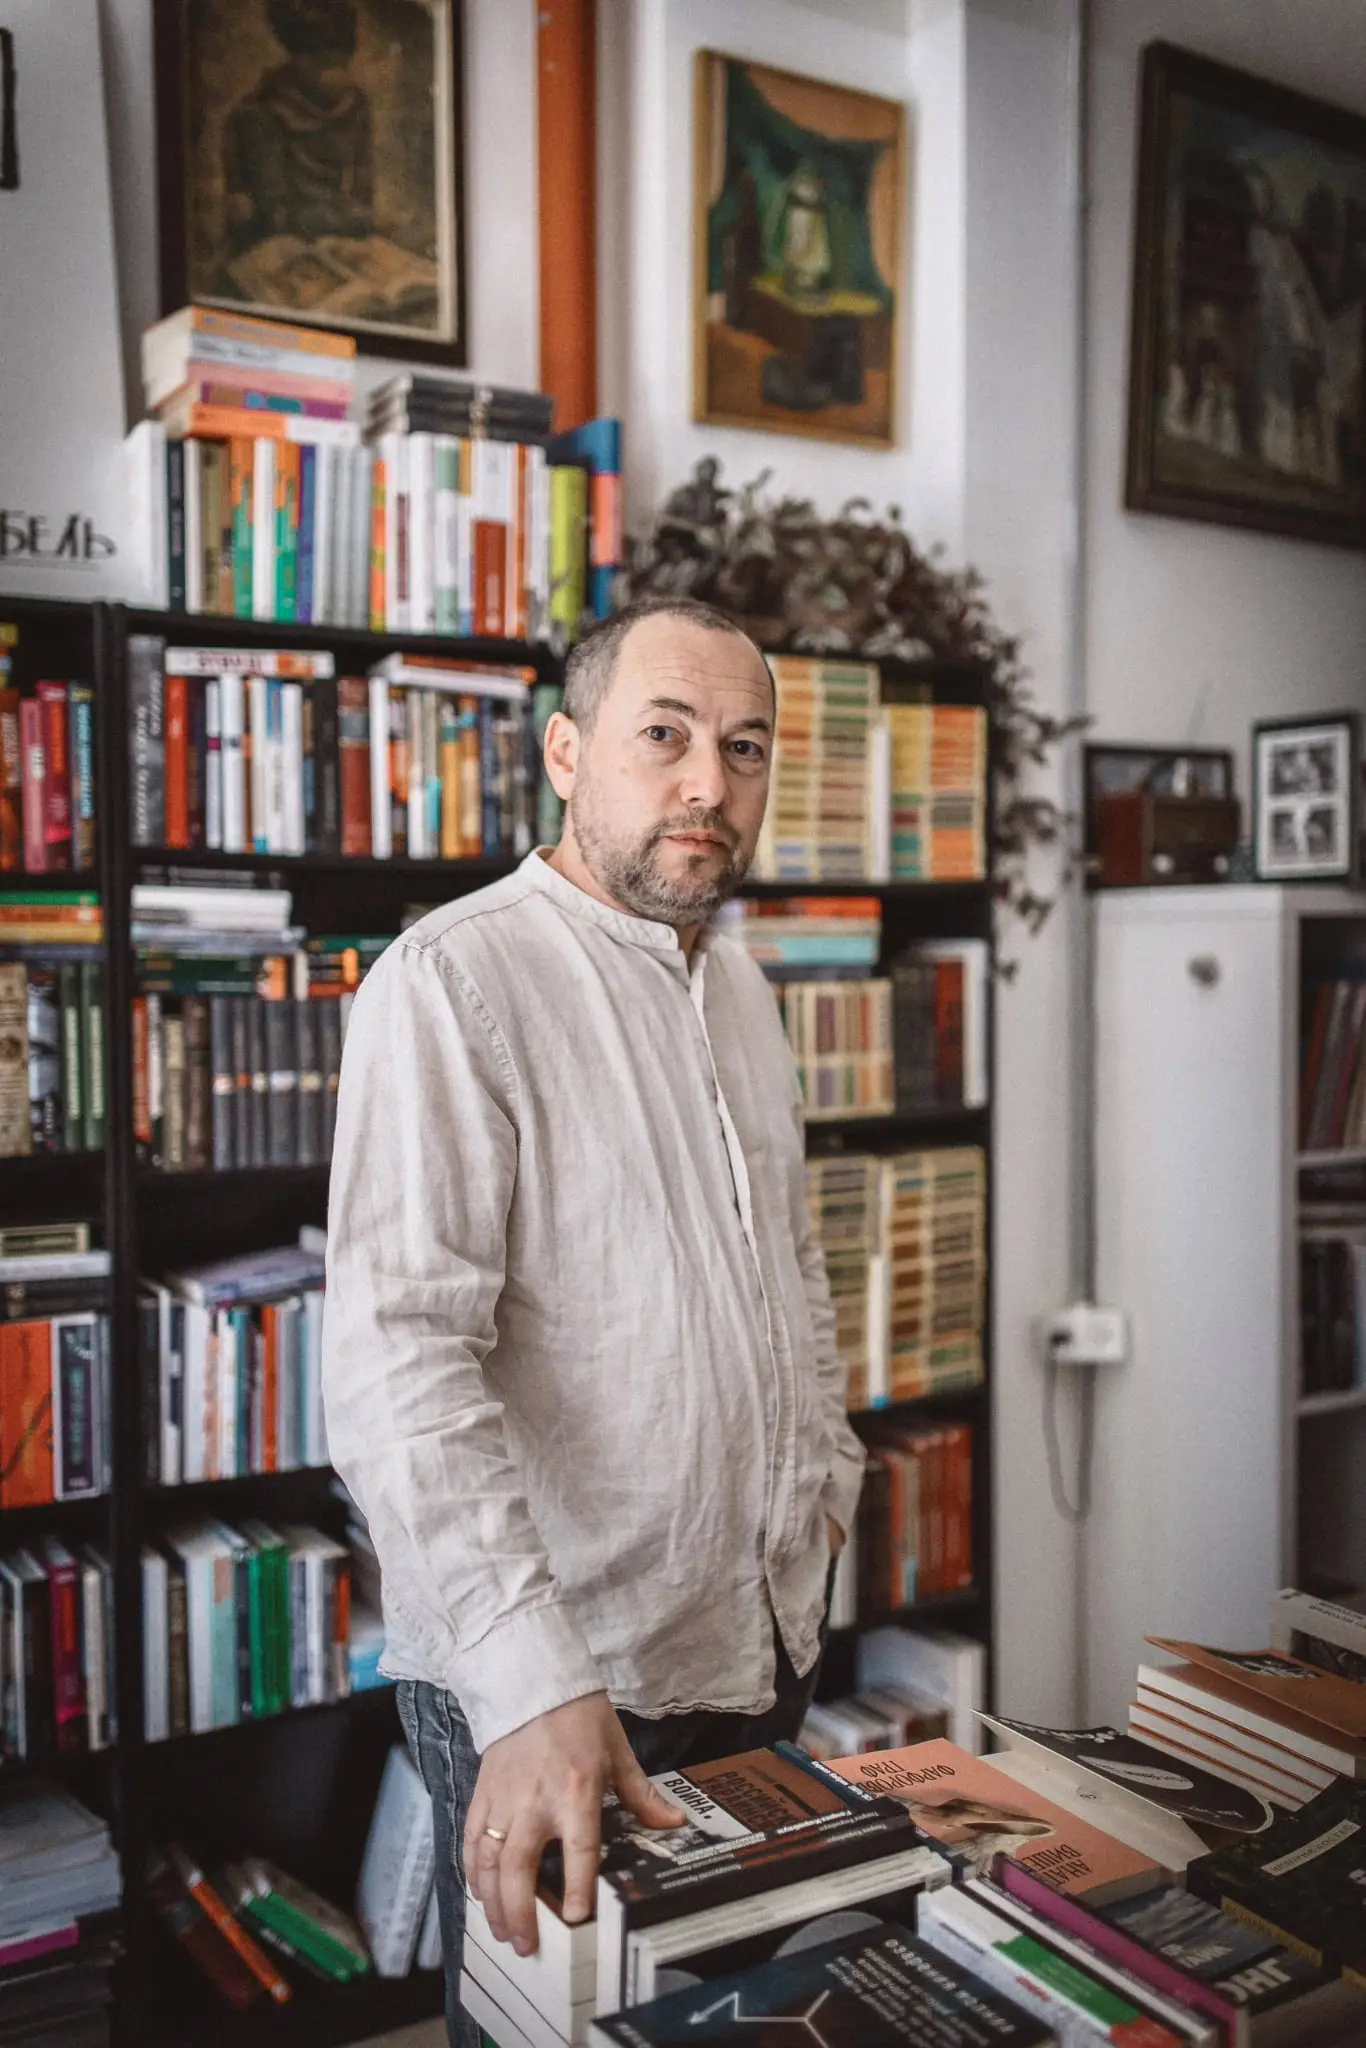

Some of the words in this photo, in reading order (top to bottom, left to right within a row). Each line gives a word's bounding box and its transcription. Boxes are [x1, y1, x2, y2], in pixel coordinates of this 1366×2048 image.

[860, 1760, 905, 1778] ГРАФ
[1022, 1843, 1083, 1874] ВИШЕ
[1046, 1858, 1093, 1887] АНАТ
